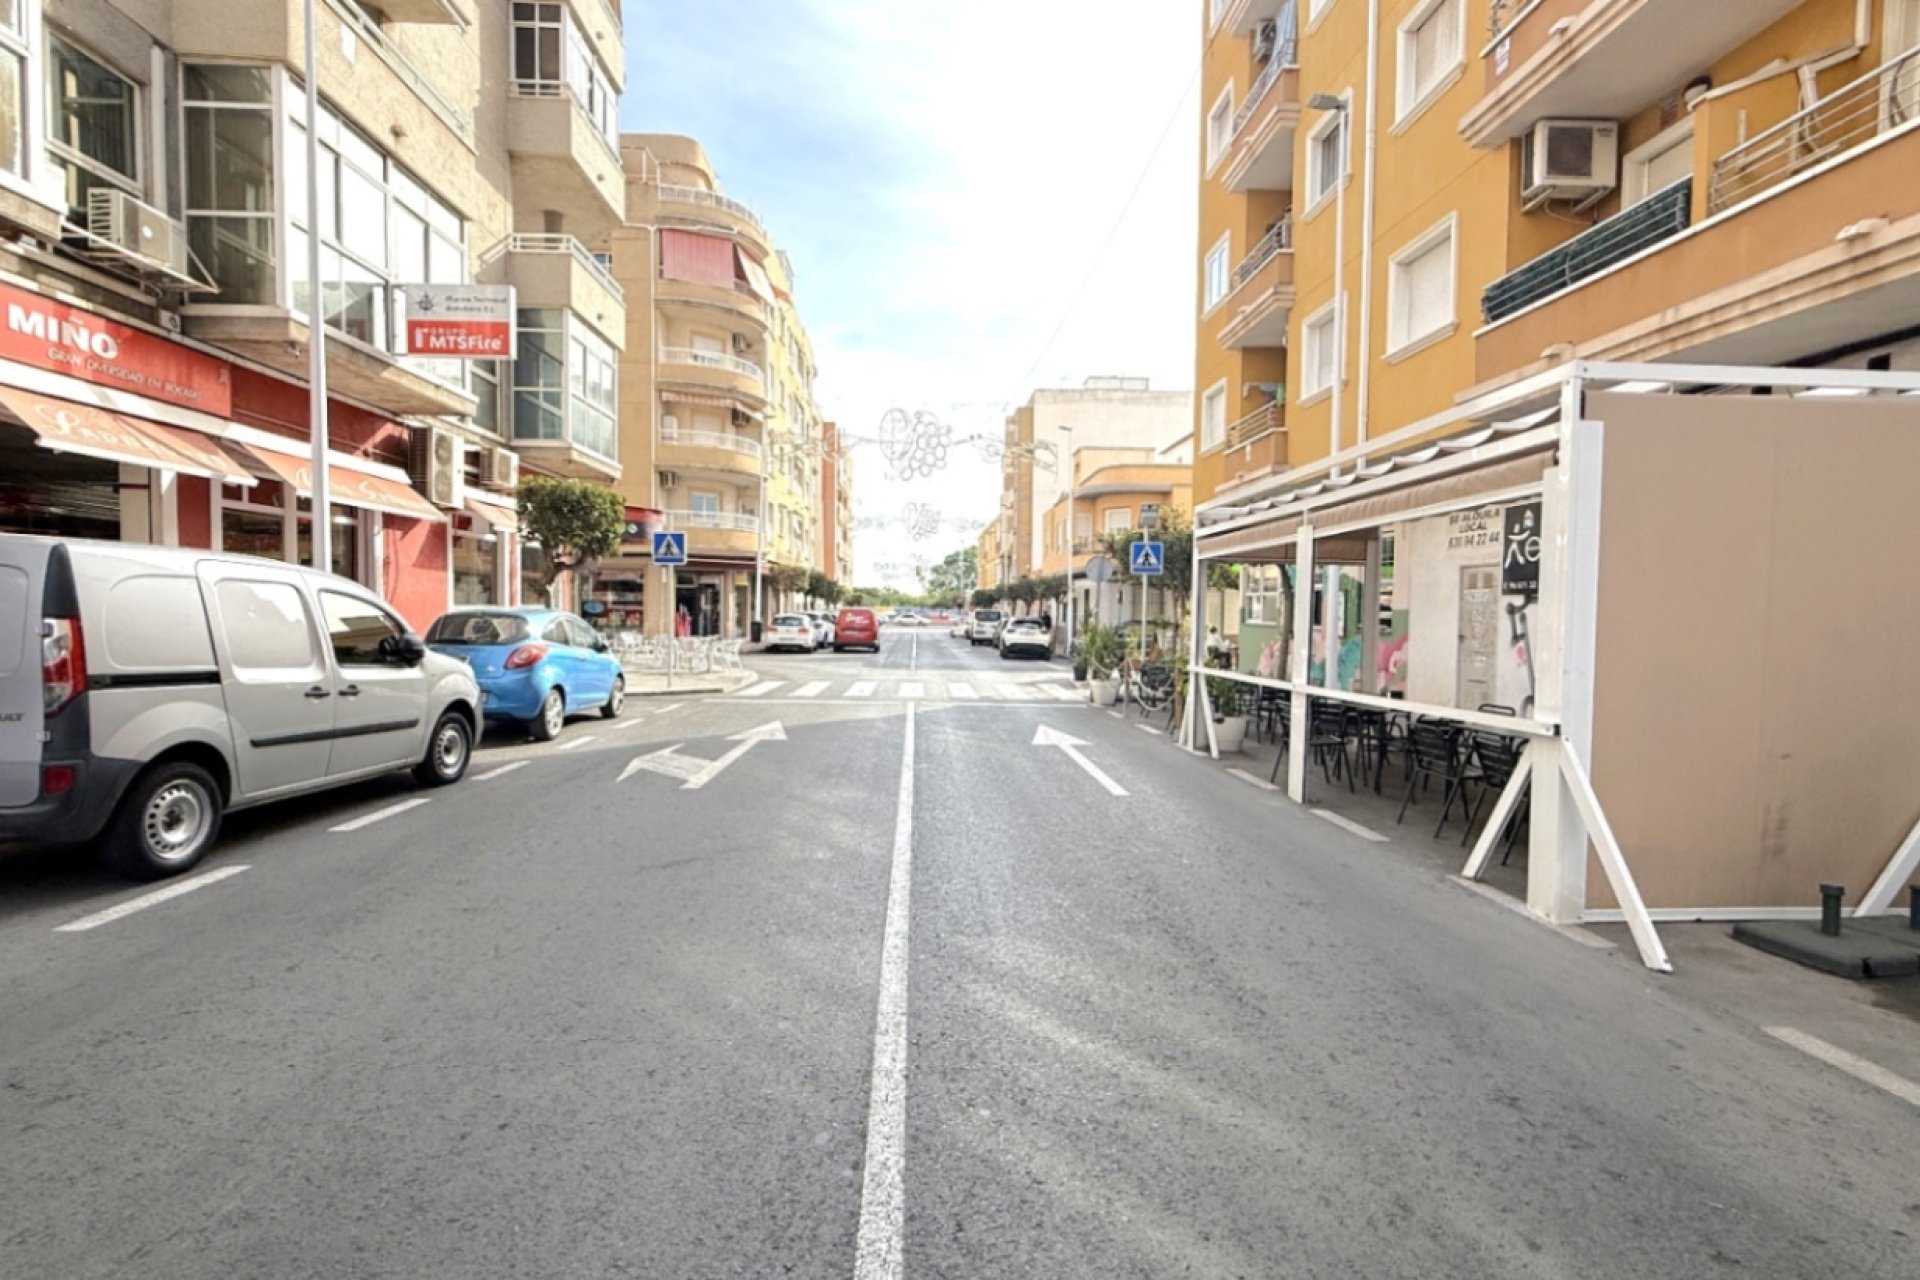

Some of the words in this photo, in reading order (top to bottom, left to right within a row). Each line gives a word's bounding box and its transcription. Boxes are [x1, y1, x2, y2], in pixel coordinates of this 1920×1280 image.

[7, 303, 119, 360] MIÑO
[429, 335, 502, 350] MTSFire
[48, 348, 83, 368] GRAN
[86, 359, 144, 386] DIVERSIDAD
[1458, 520, 1487, 533] LOCAL
